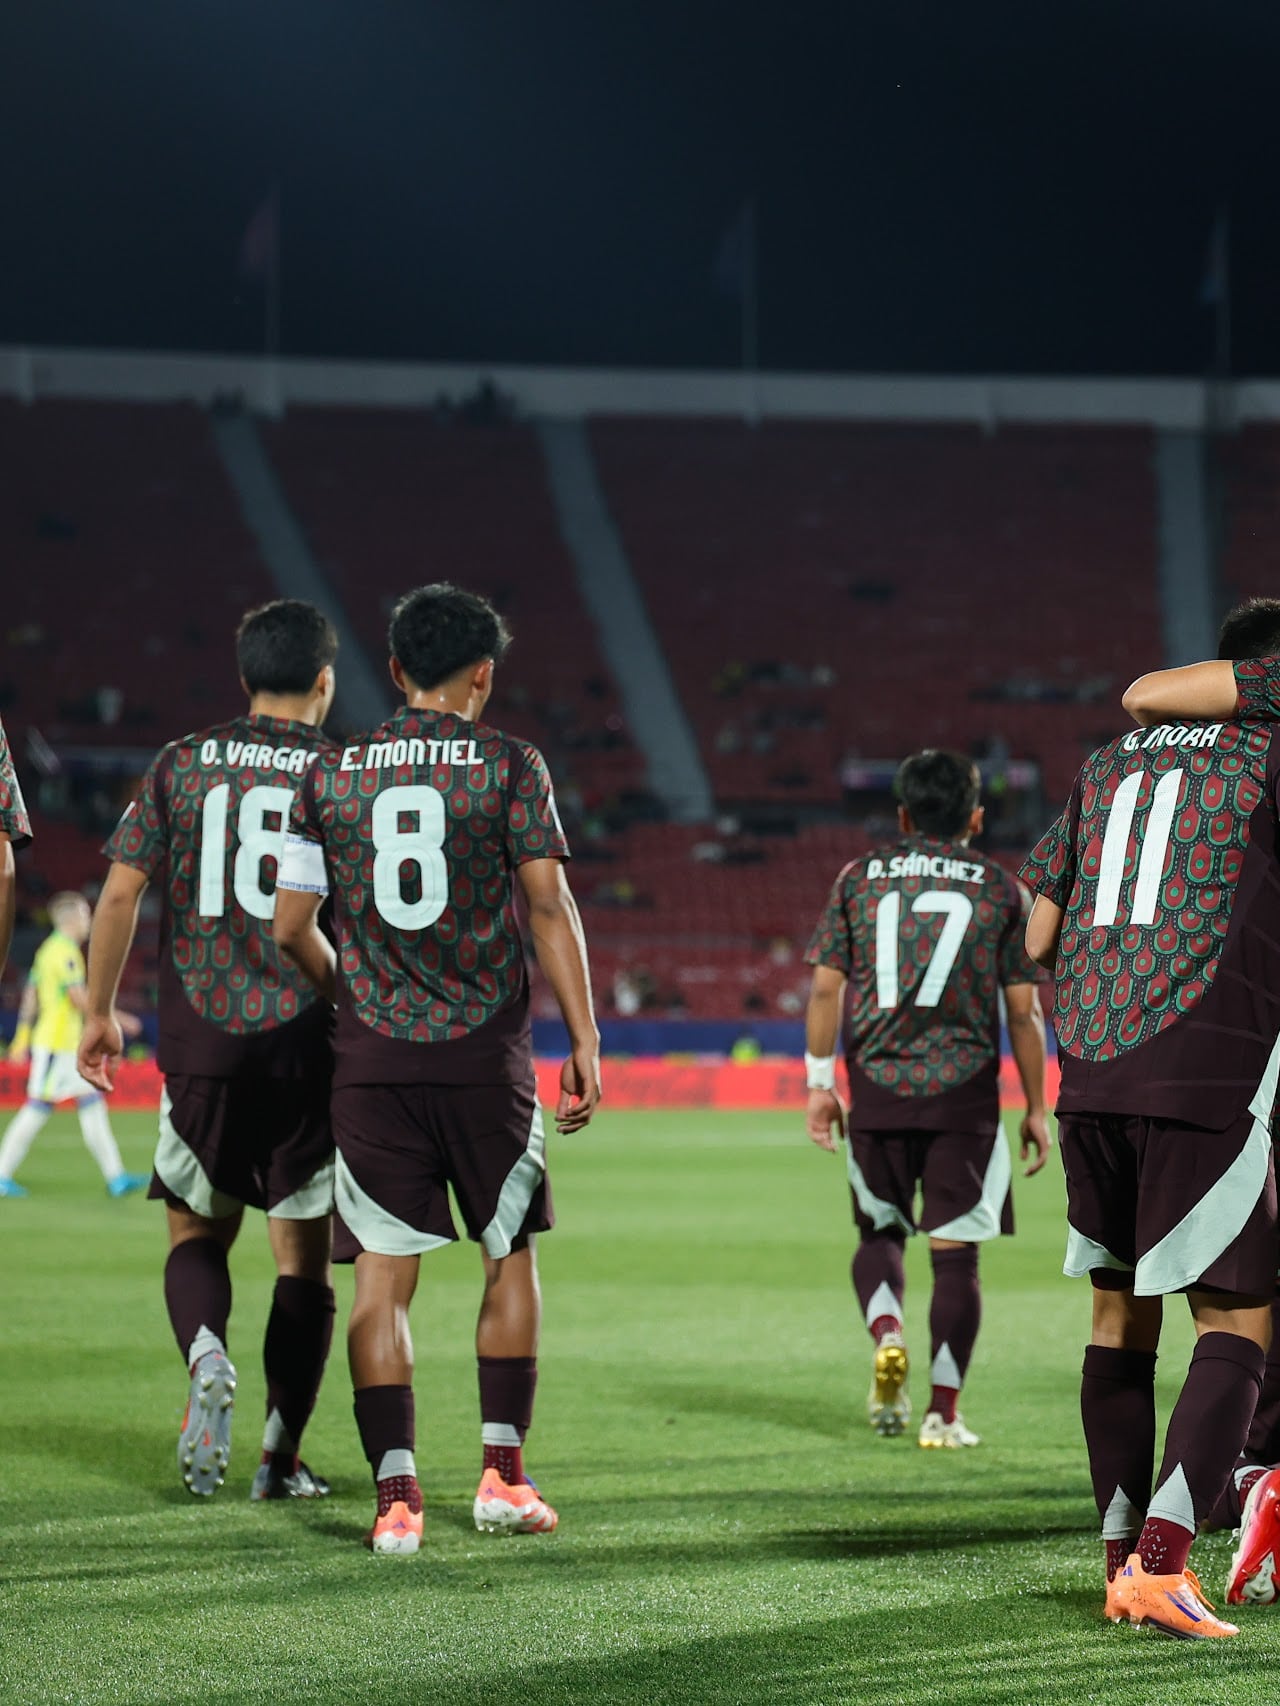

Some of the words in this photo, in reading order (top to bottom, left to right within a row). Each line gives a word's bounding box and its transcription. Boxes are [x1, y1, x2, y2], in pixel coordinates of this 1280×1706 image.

[199, 783, 295, 920] 18
[372, 785, 449, 931] 8
[1092, 768, 1184, 926] 11
[876, 890, 974, 1009] 17
